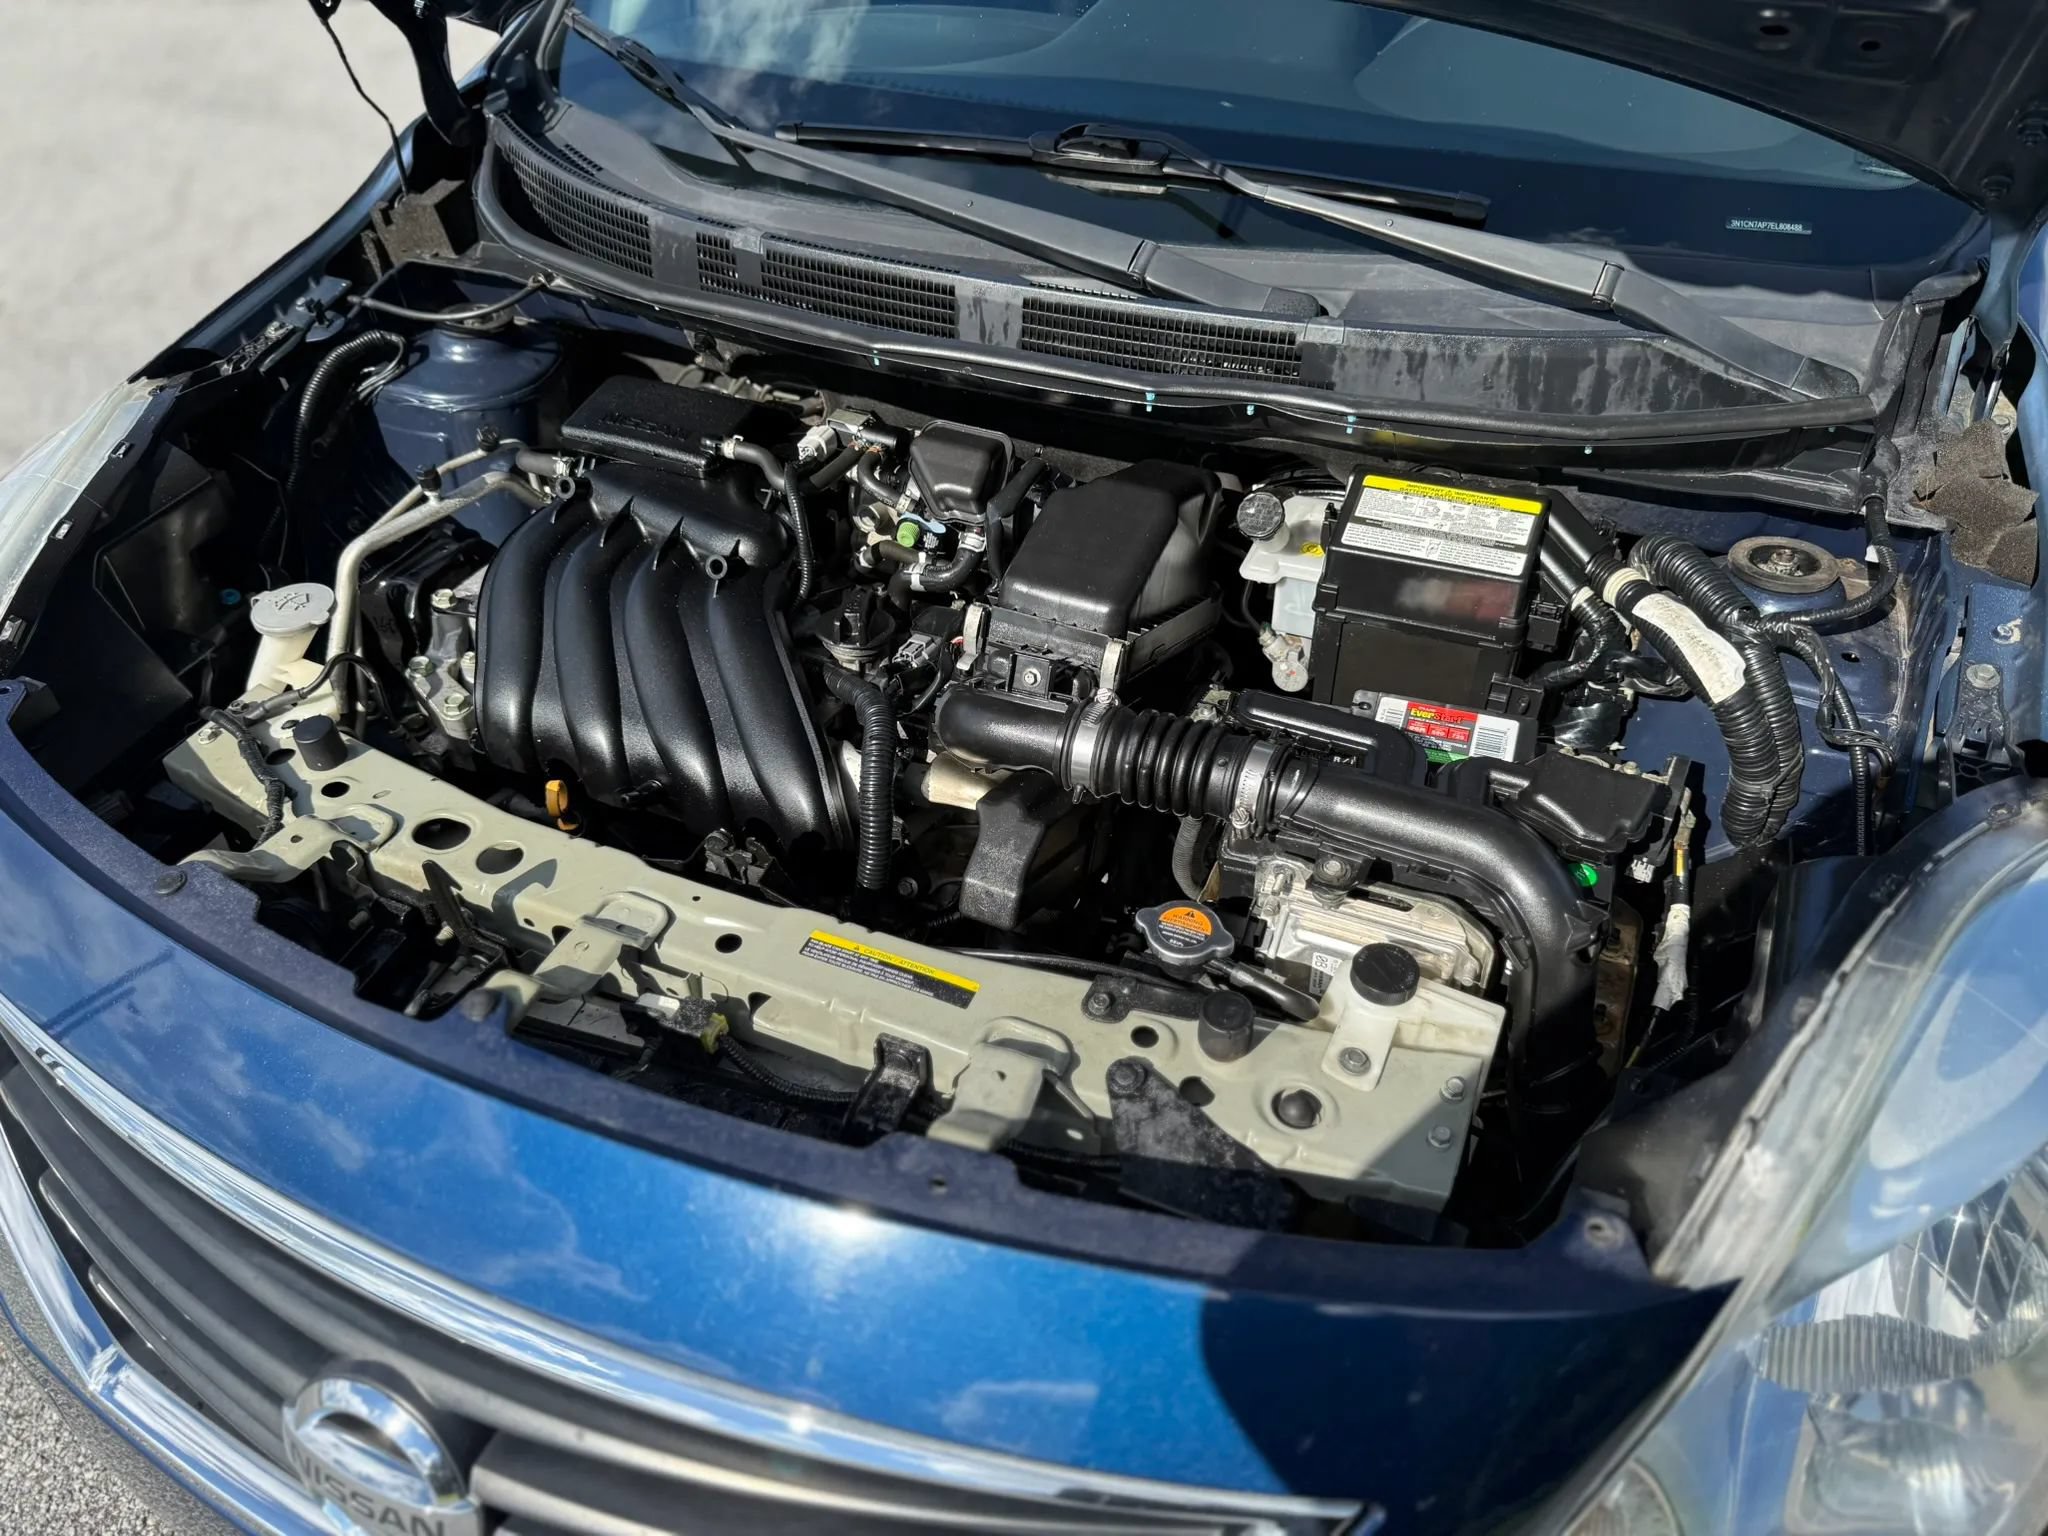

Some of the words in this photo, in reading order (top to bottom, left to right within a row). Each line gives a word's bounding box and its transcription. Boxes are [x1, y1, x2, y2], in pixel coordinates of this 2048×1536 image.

[864, 948, 892, 961] CAUTION
[900, 959, 936, 974] ATTENTION
[291, 1441, 445, 1536] NISSAN
